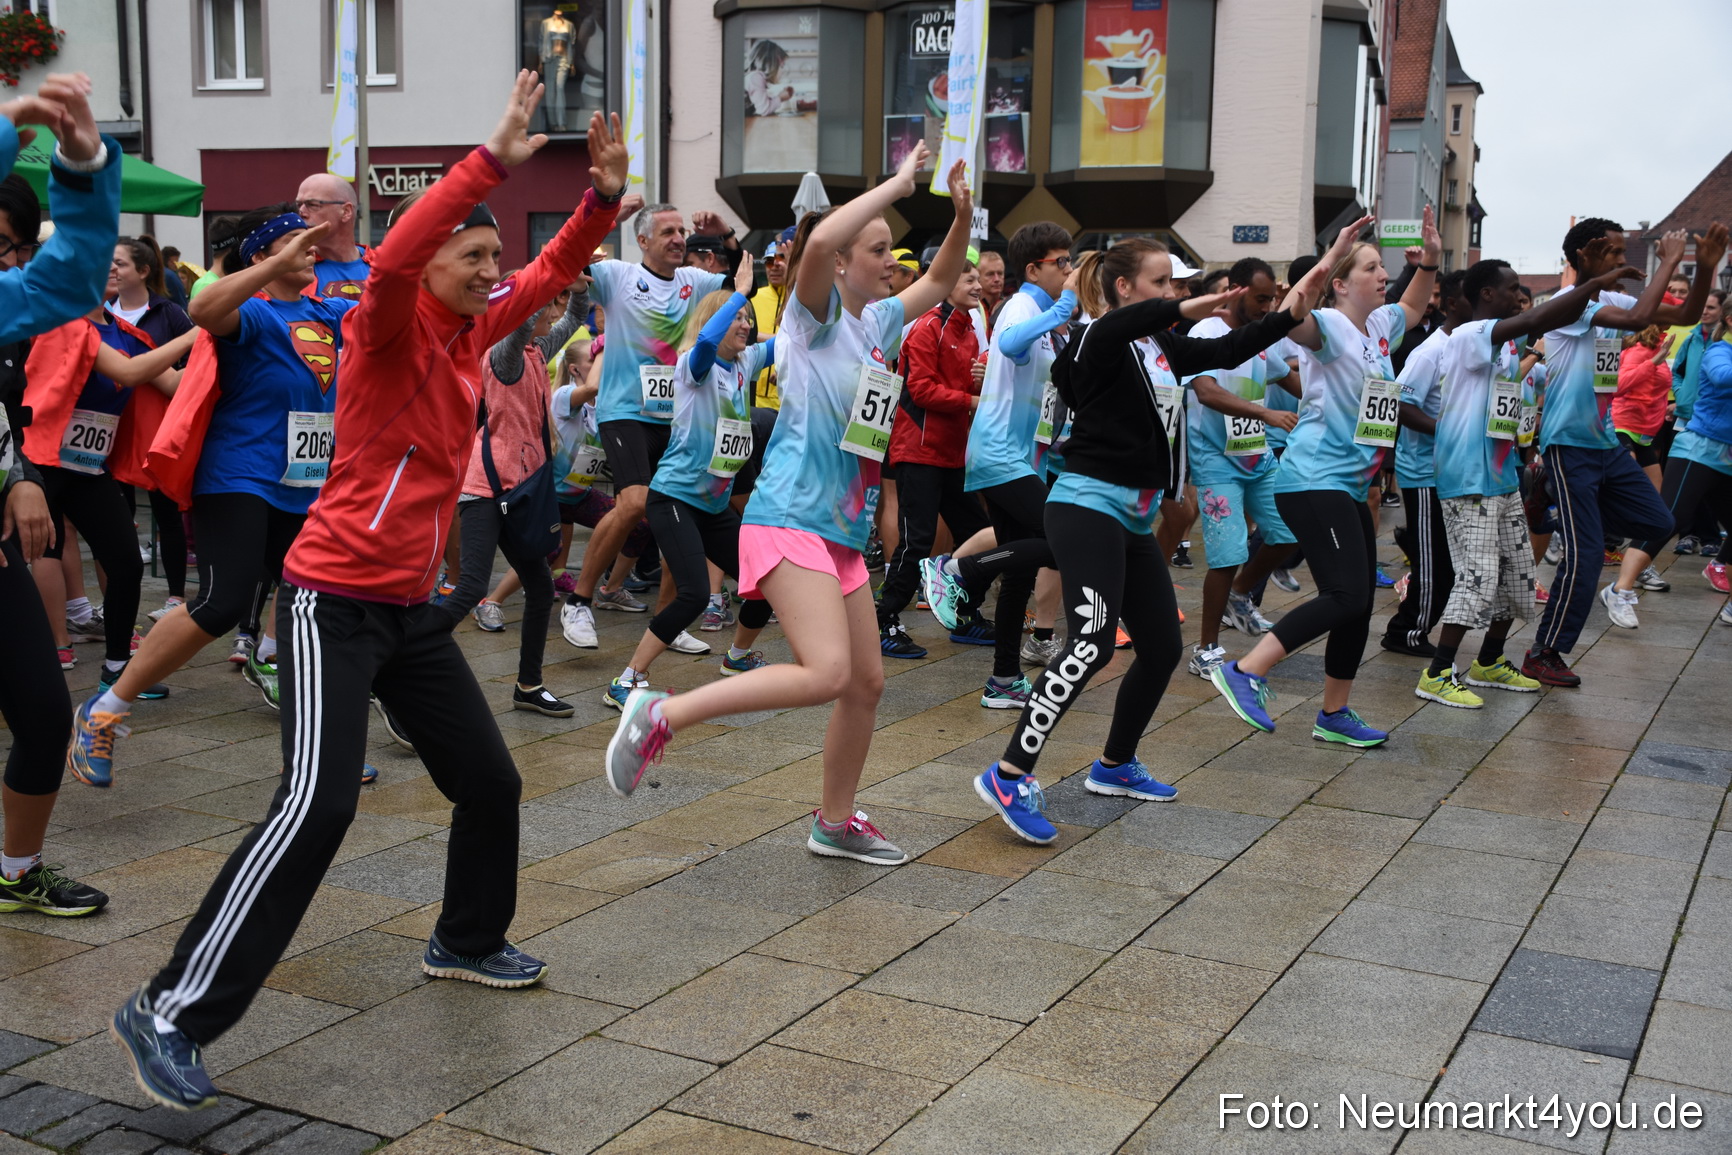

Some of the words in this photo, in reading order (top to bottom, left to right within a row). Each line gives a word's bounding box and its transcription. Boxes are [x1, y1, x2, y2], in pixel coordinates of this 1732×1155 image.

[1384, 224, 1416, 234] GEERS
[70, 424, 113, 453] 2061
[296, 431, 332, 459] 2063
[305, 466, 325, 478] Gisela
[1020, 640, 1099, 755] adidas
